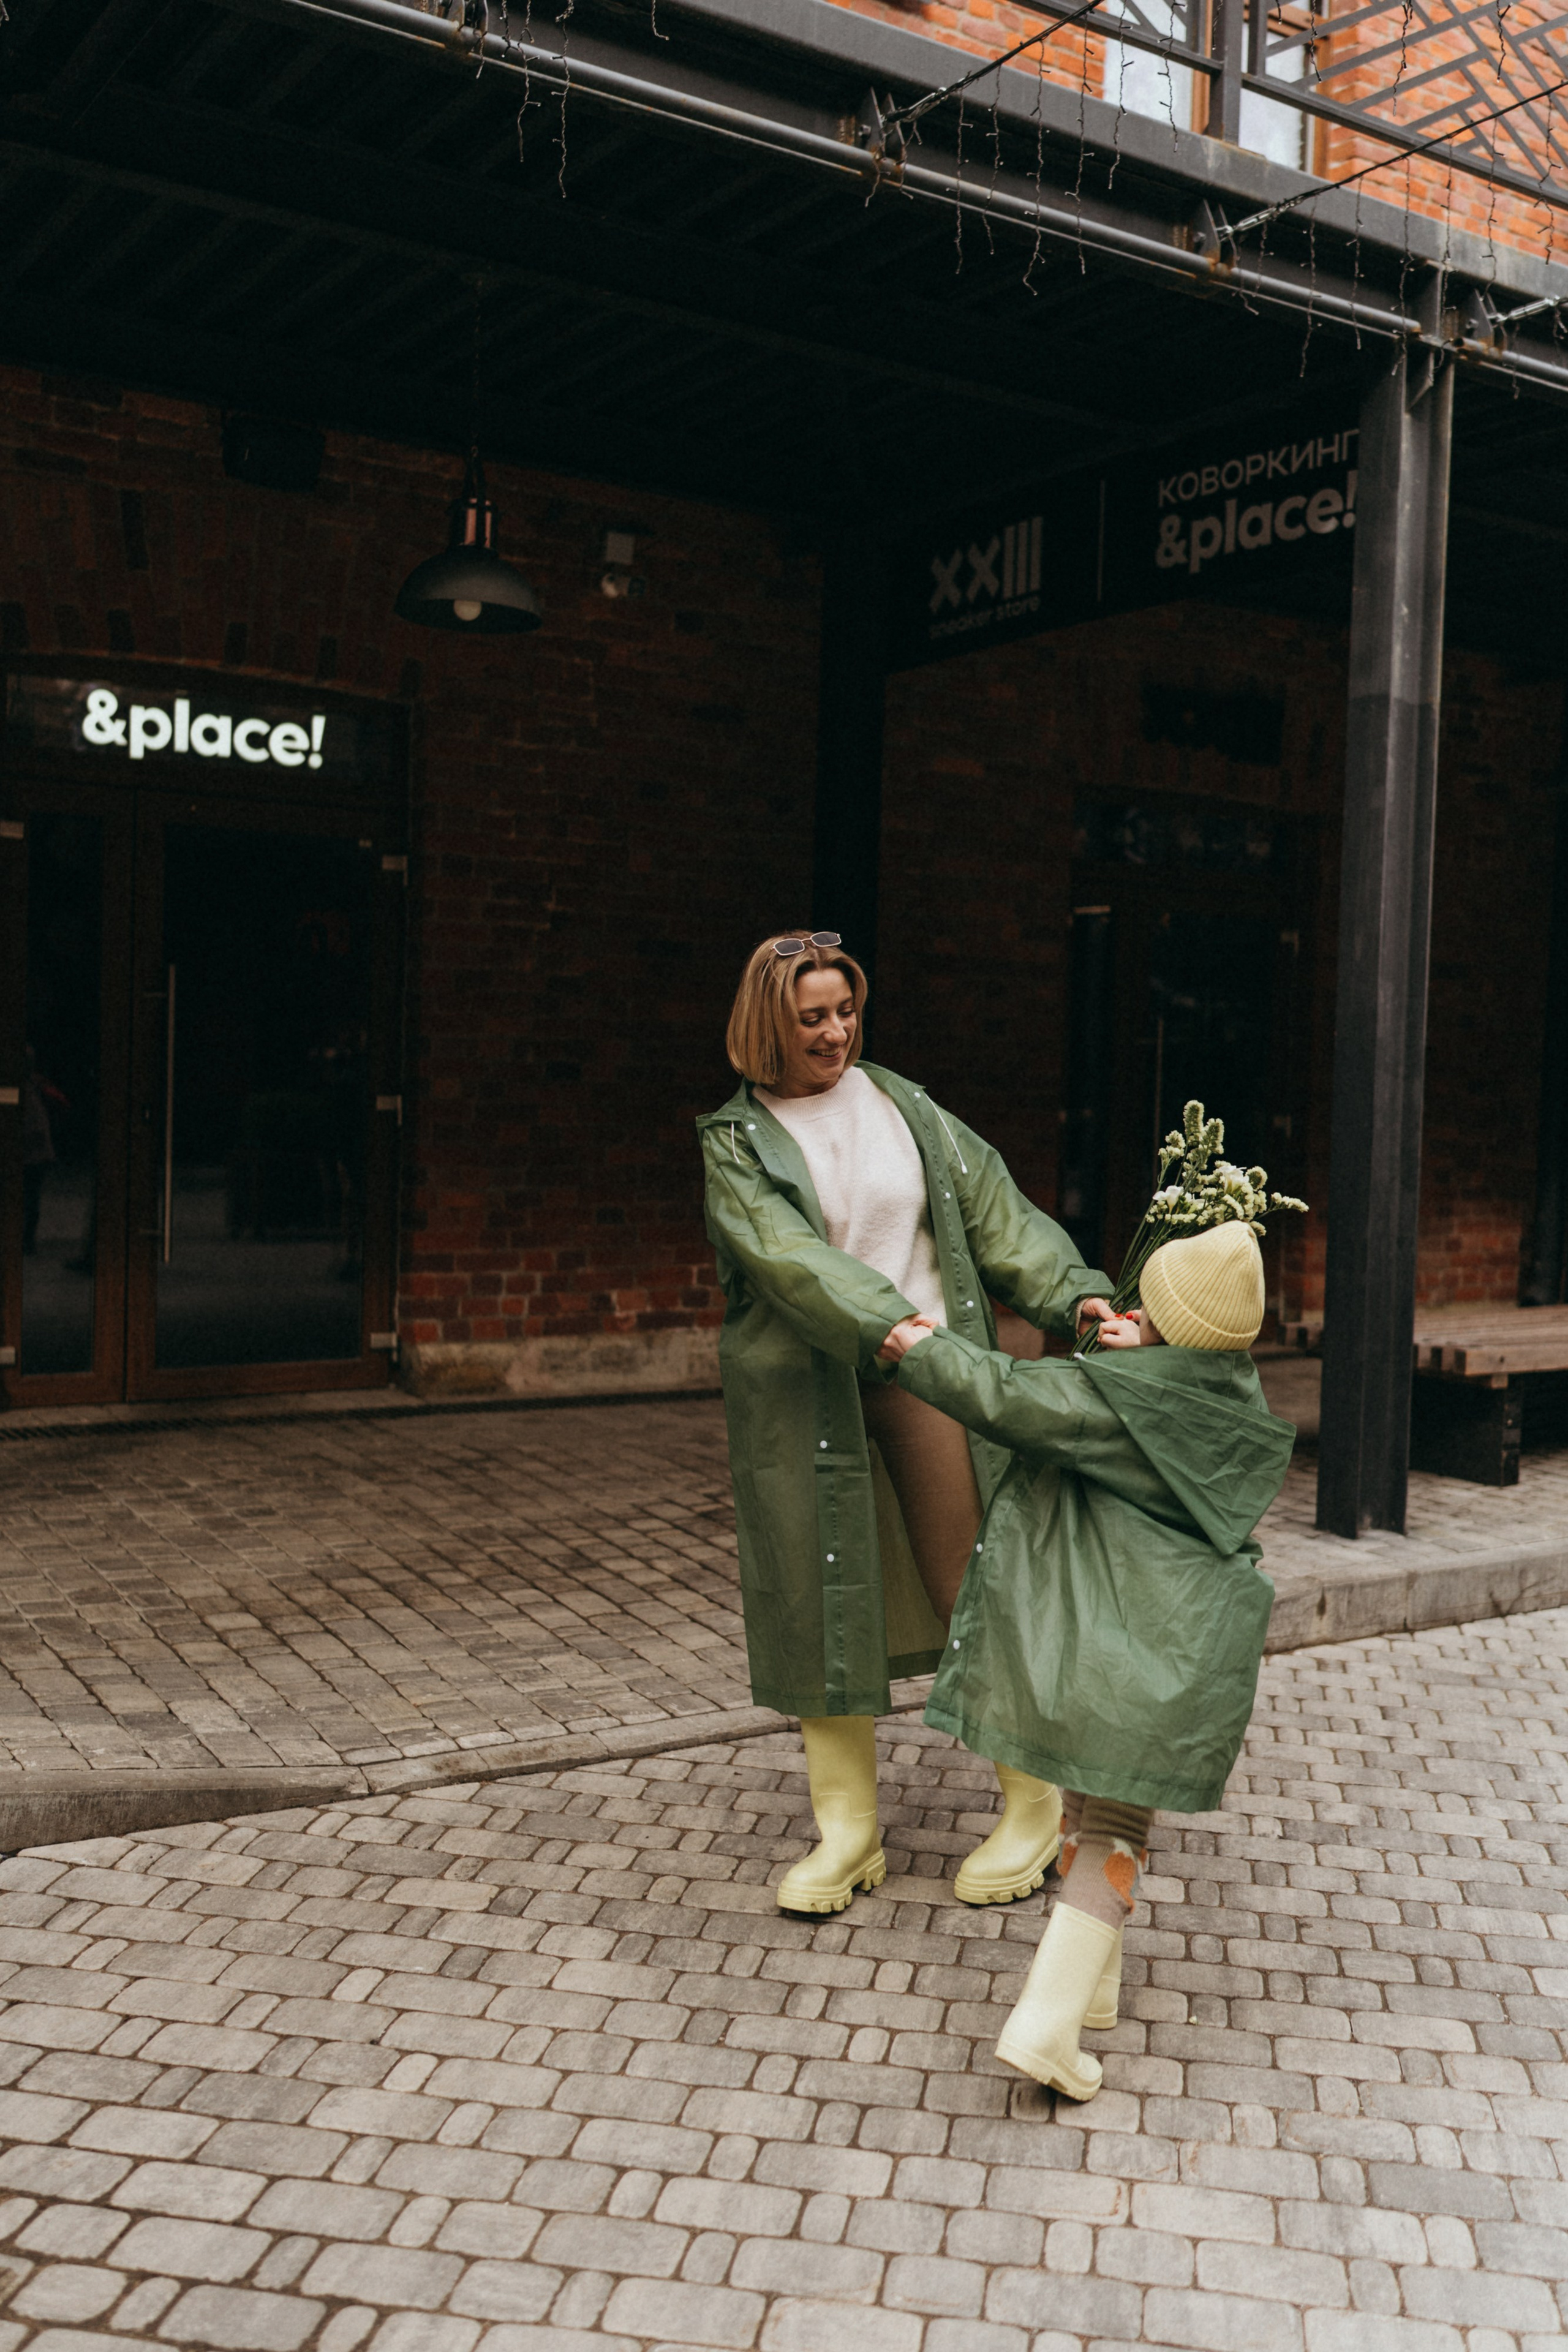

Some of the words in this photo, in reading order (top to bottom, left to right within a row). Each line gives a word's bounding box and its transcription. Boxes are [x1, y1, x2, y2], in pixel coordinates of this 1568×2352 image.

[1158, 429, 1360, 508] КОВОРКИНГ
[1155, 469, 1358, 575] &place!
[995, 595, 1040, 621] store
[81, 688, 326, 769] &place!
